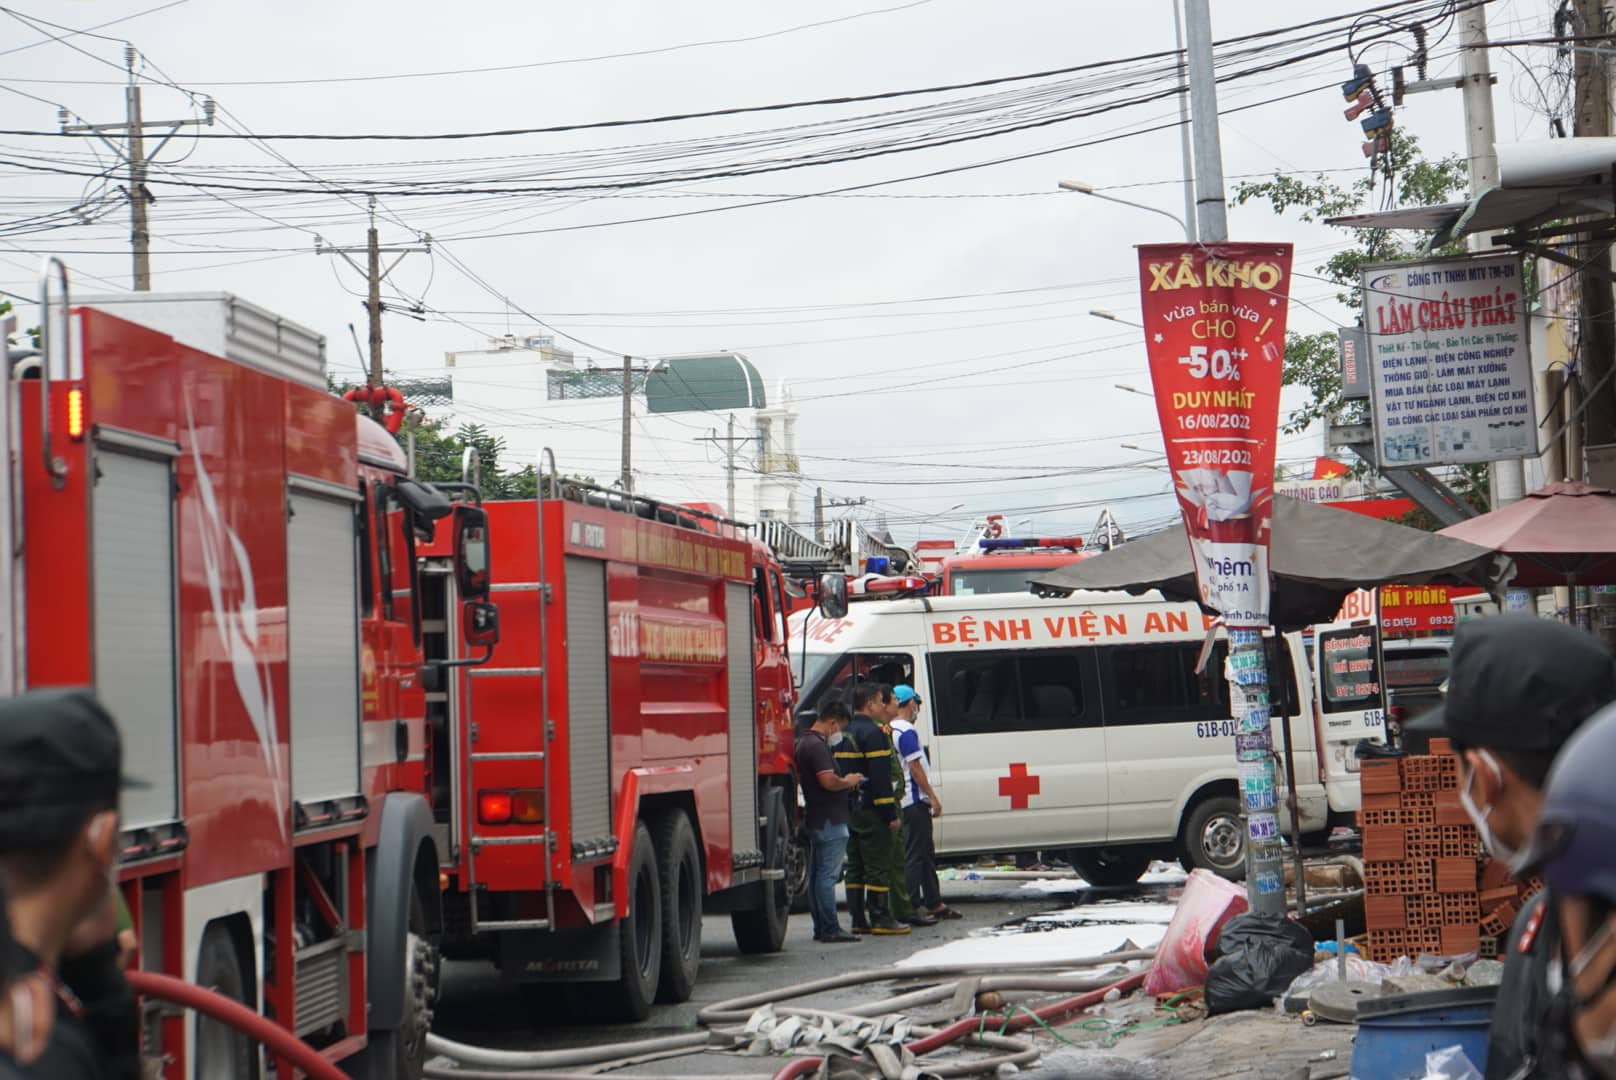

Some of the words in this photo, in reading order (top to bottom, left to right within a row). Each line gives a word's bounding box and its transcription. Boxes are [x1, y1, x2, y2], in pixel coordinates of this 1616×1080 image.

[1149, 254, 1199, 291] XẢ
[1206, 261, 1280, 290] KHO
[1408, 271, 1430, 287] CÔNG
[1432, 271, 1441, 284] TY
[1445, 269, 1466, 283] TNHH
[1469, 267, 1486, 280] MTV
[1163, 305, 1195, 322] vừa
[1200, 300, 1229, 313] bán
[1232, 305, 1260, 323] vừa
[1377, 296, 1414, 334] LÂM
[1418, 290, 1465, 332] CHÂU
[1470, 285, 1516, 327] PHÁT
[1192, 320, 1236, 339] CHO
[1458, 350, 1481, 361] CÔNG
[1384, 371, 1411, 383] THÔNG
[1173, 391, 1211, 409] DUY
[1385, 387, 1403, 397] MUA
[1178, 414, 1250, 429] 16/08/2022
[1183, 450, 1252, 464] 23/08/2022
[1238, 583, 1249, 592] 1A
[1406, 586, 1446, 605] PHÒNG
[932, 613, 1032, 647] BỆNH
[1044, 610, 1127, 641] VIỆN
[1144, 611, 1189, 633] AN
[1429, 615, 1454, 625] 0932
[1197, 720, 1236, 738] 61B-01
